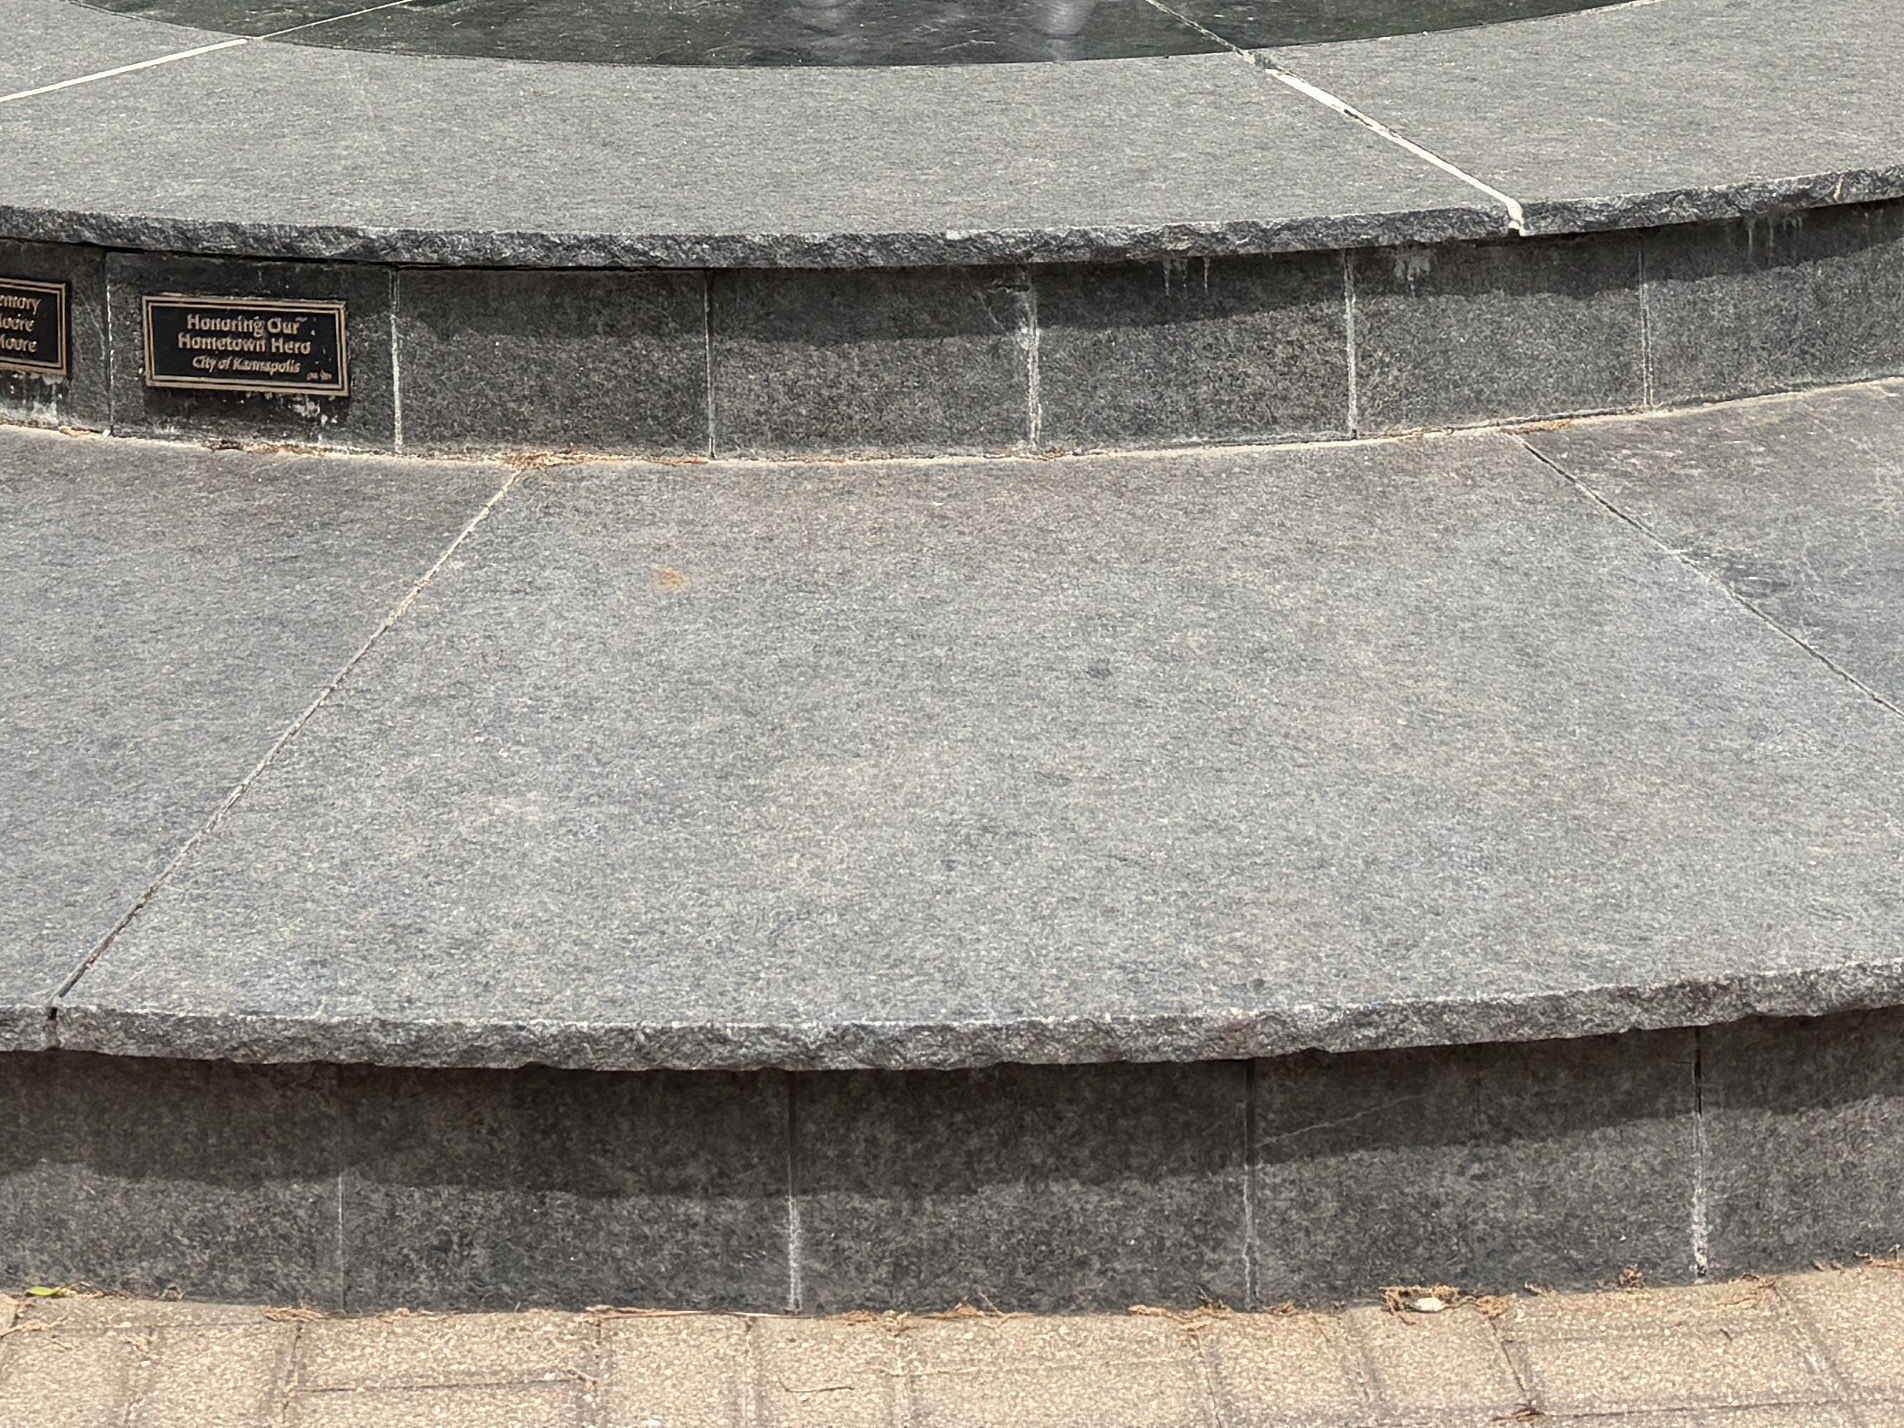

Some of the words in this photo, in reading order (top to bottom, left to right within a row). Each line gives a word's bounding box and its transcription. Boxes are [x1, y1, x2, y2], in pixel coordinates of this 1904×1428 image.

[186, 313, 264, 336] Honoring
[267, 316, 301, 335] Our
[177, 332, 266, 353] Hometown
[271, 337, 312, 355] Hero
[192, 356, 216, 372] City
[217, 356, 231, 370] of
[232, 357, 301, 375] Kannapolis
